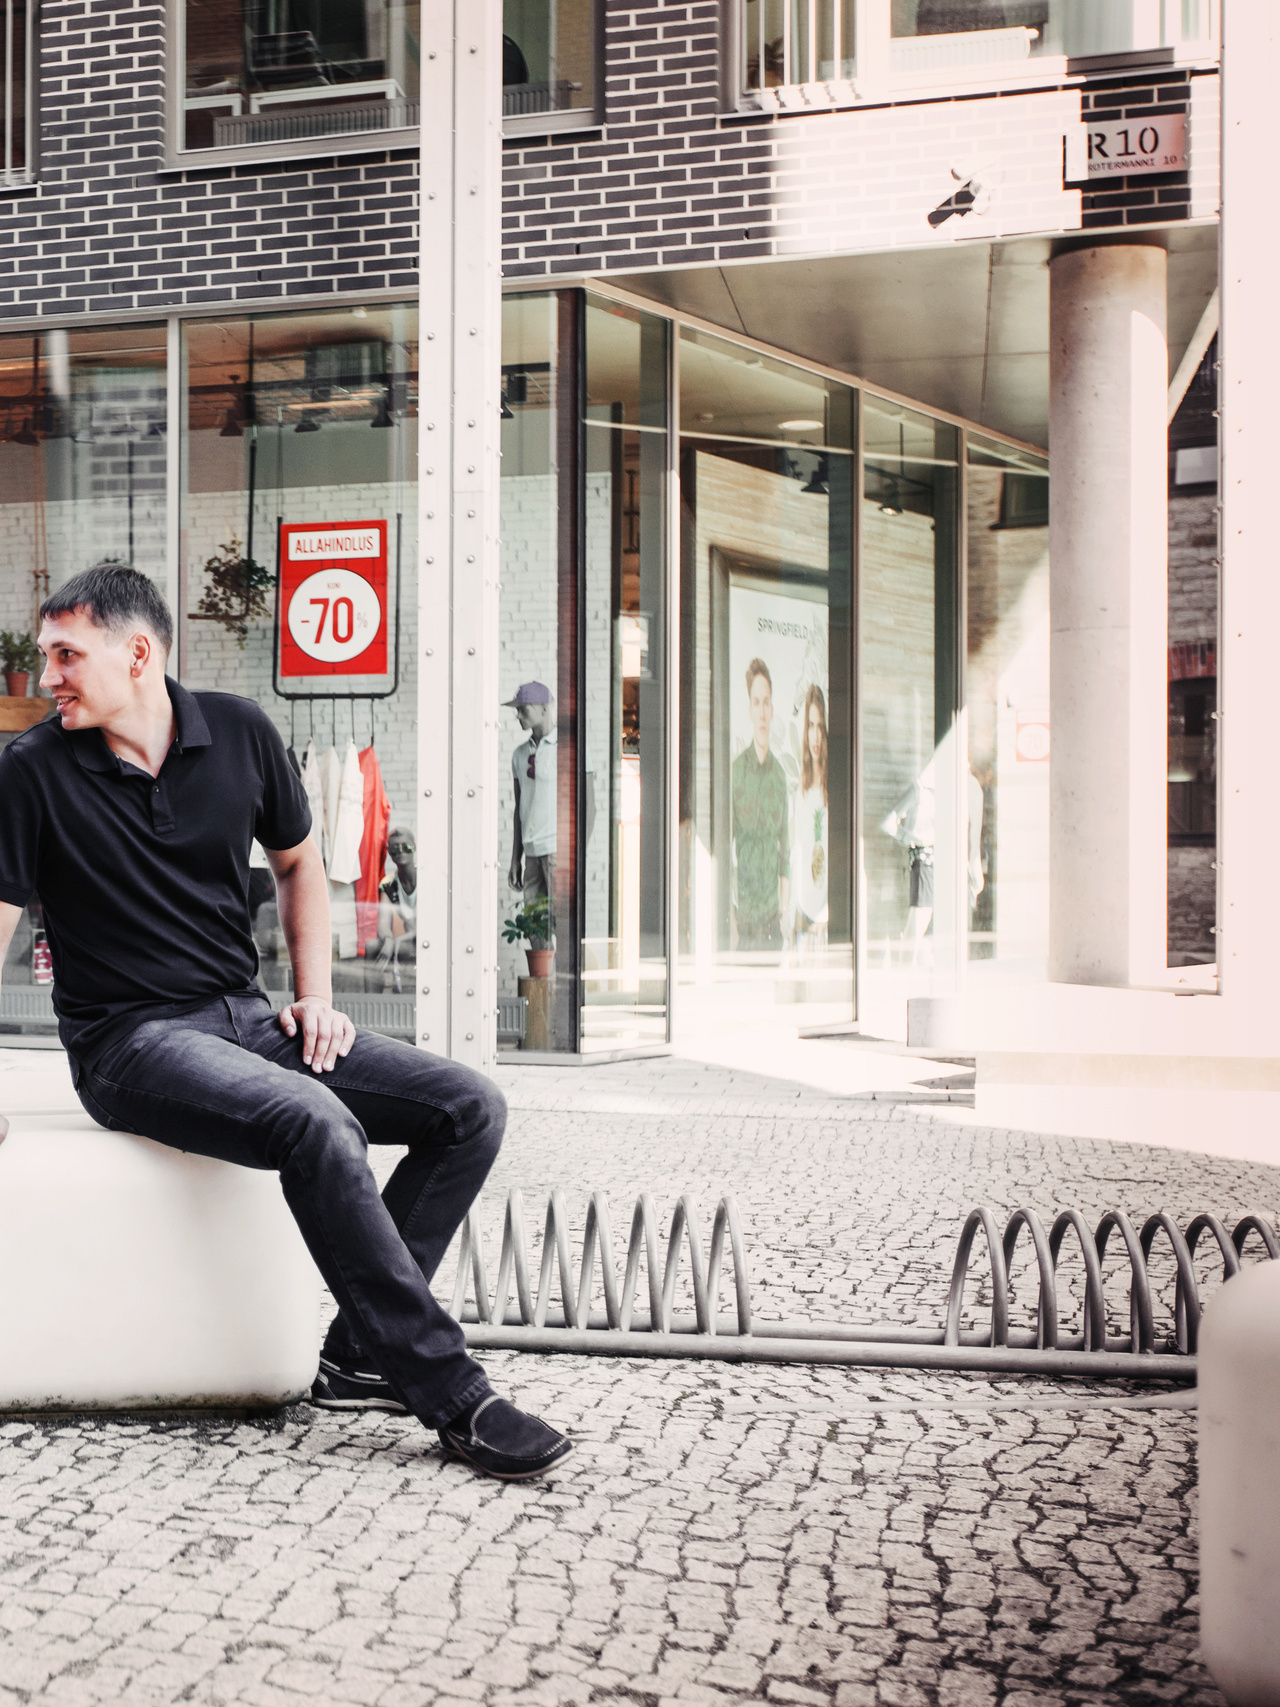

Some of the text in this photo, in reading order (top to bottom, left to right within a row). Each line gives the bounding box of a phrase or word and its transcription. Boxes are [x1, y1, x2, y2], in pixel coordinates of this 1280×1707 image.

[1088, 127, 1159, 159] R10
[1163, 155, 1178, 166] 10
[295, 536, 373, 553] ALLAHINDLUS
[757, 617, 808, 639] SPRINGFIELD
